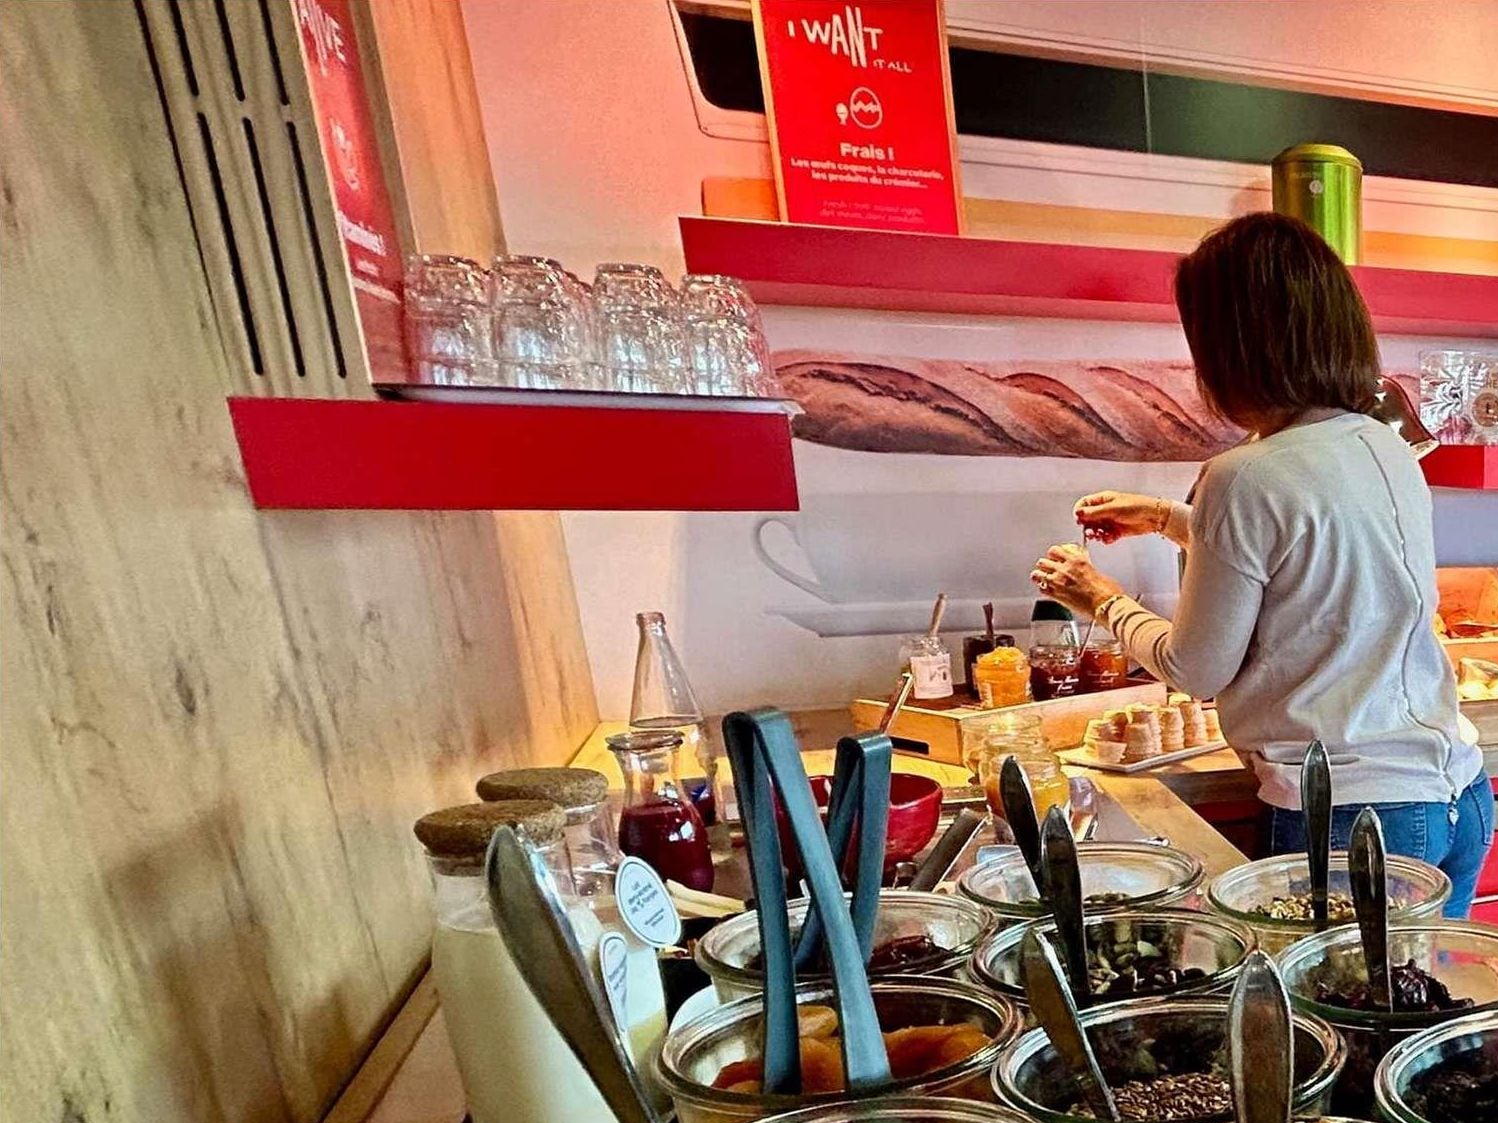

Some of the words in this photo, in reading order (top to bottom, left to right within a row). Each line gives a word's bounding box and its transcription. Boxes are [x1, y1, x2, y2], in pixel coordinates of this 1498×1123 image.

[787, 19, 796, 38] I
[800, 4, 884, 68] WANT
[873, 58, 885, 69] IT
[887, 60, 913, 74] ALL
[839, 142, 886, 160] Frais
